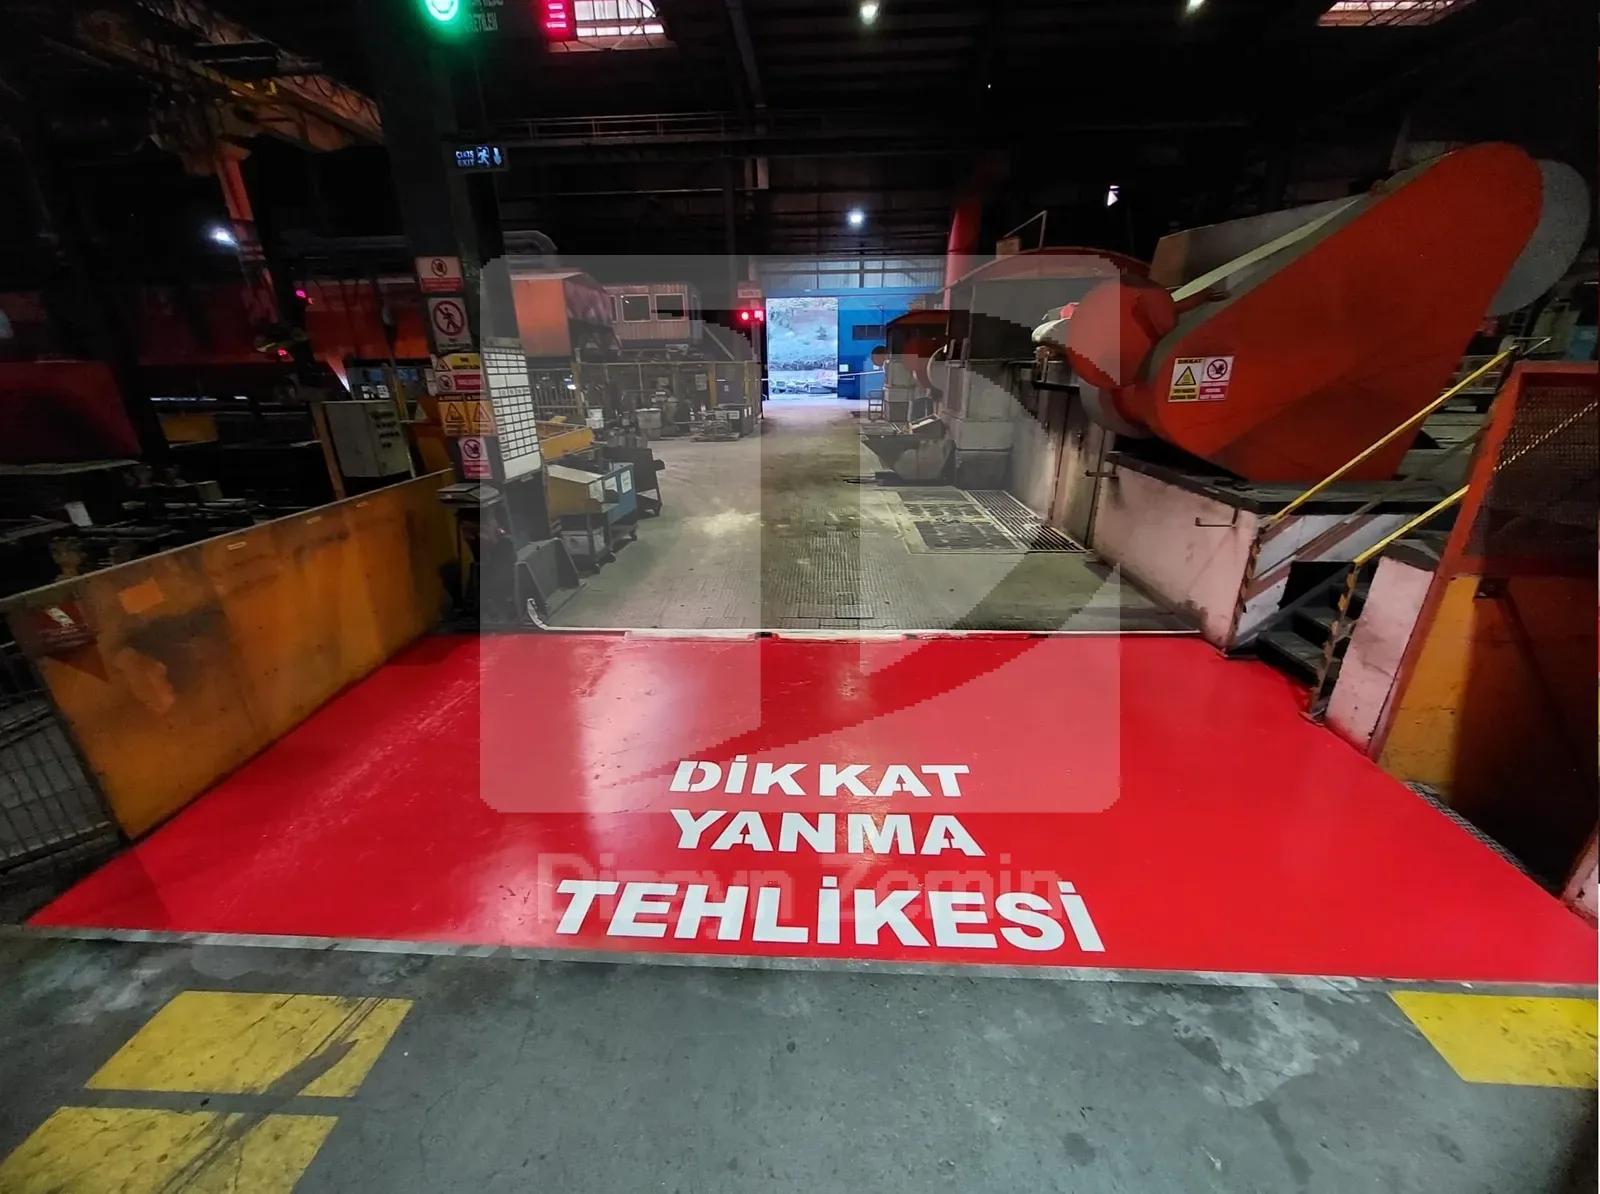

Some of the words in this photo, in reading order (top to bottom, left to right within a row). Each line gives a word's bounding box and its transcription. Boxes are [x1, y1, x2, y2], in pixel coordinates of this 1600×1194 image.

[668, 754, 970, 798] DİKKAT
[670, 809, 986, 857] YANMA
[555, 875, 1106, 953] TEHLİKESİ
